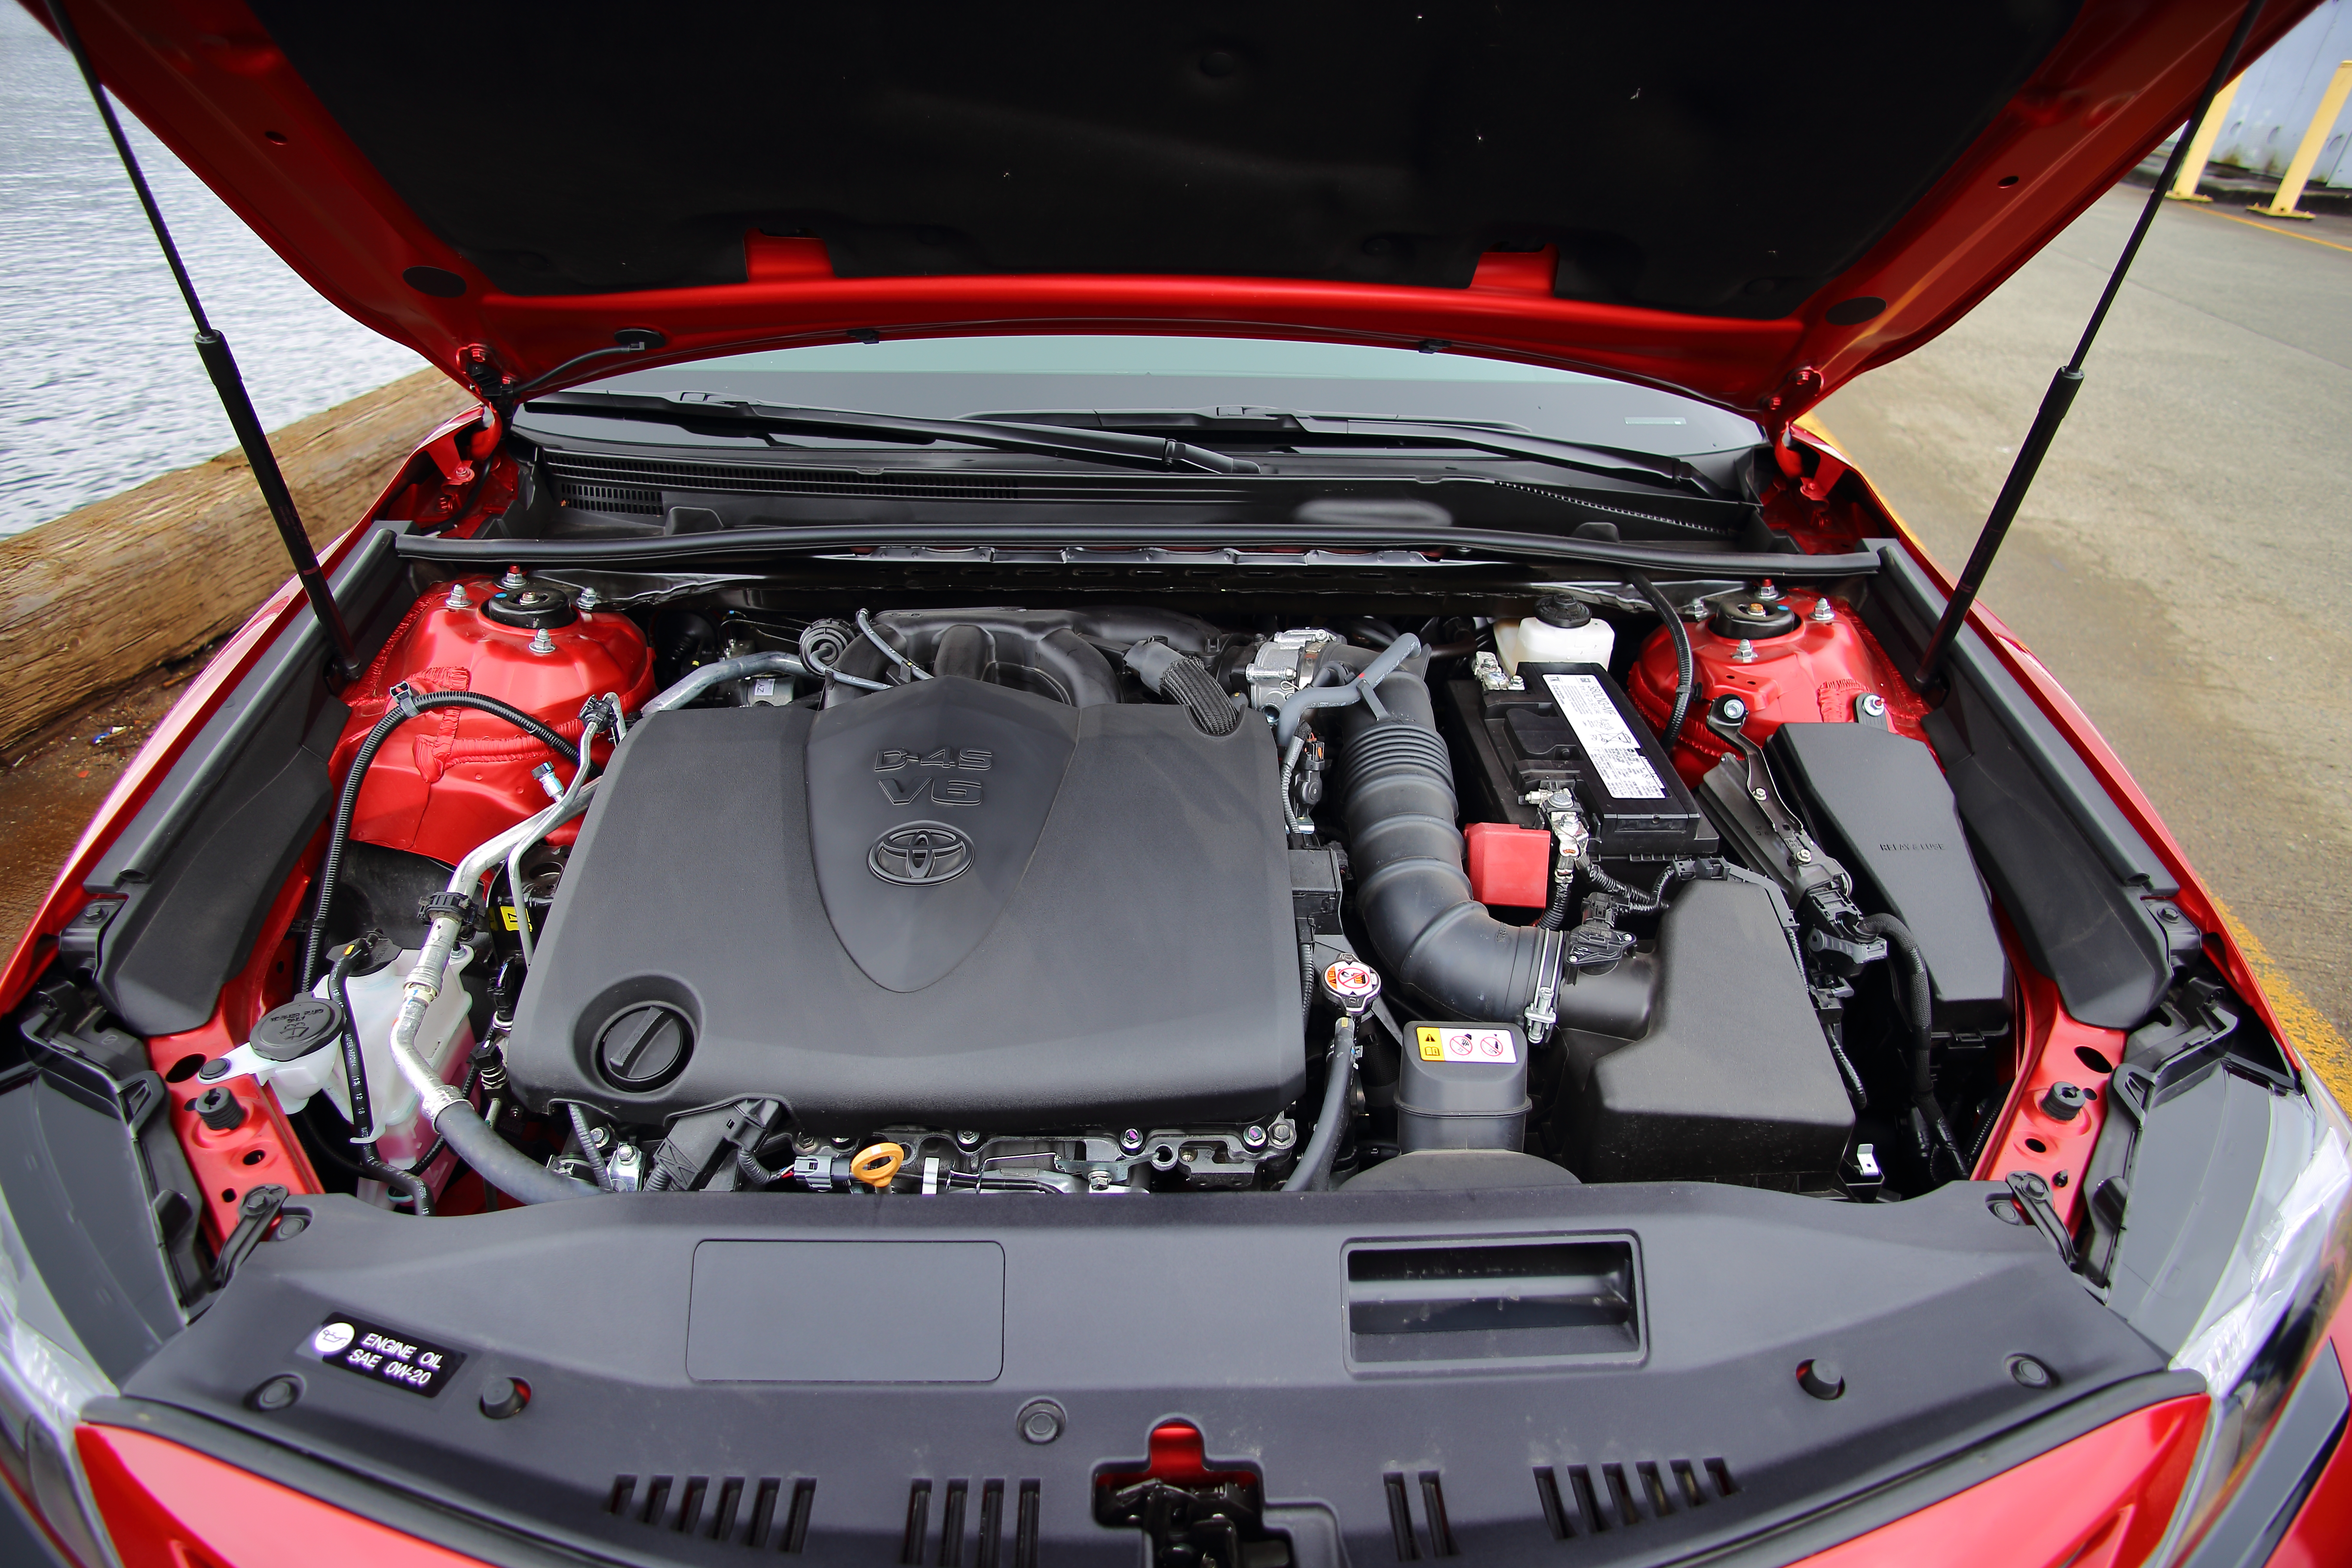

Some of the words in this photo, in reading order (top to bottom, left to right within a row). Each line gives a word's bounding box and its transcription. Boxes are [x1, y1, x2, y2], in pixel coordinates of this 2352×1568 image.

[757, 683, 765, 693] ZY
[874, 747, 992, 772] D-4S
[878, 776, 983, 806] V6
[1880, 843, 1910, 851] RELAY
[374, 945, 390, 962] COOLANT
[345, 1033, 353, 1048] WATER
[362, 1333, 418, 1359] ENGINE
[420, 1352, 443, 1369] OIL
[349, 1349, 383, 1368] SAE
[385, 1361, 432, 1384] 0W-20
